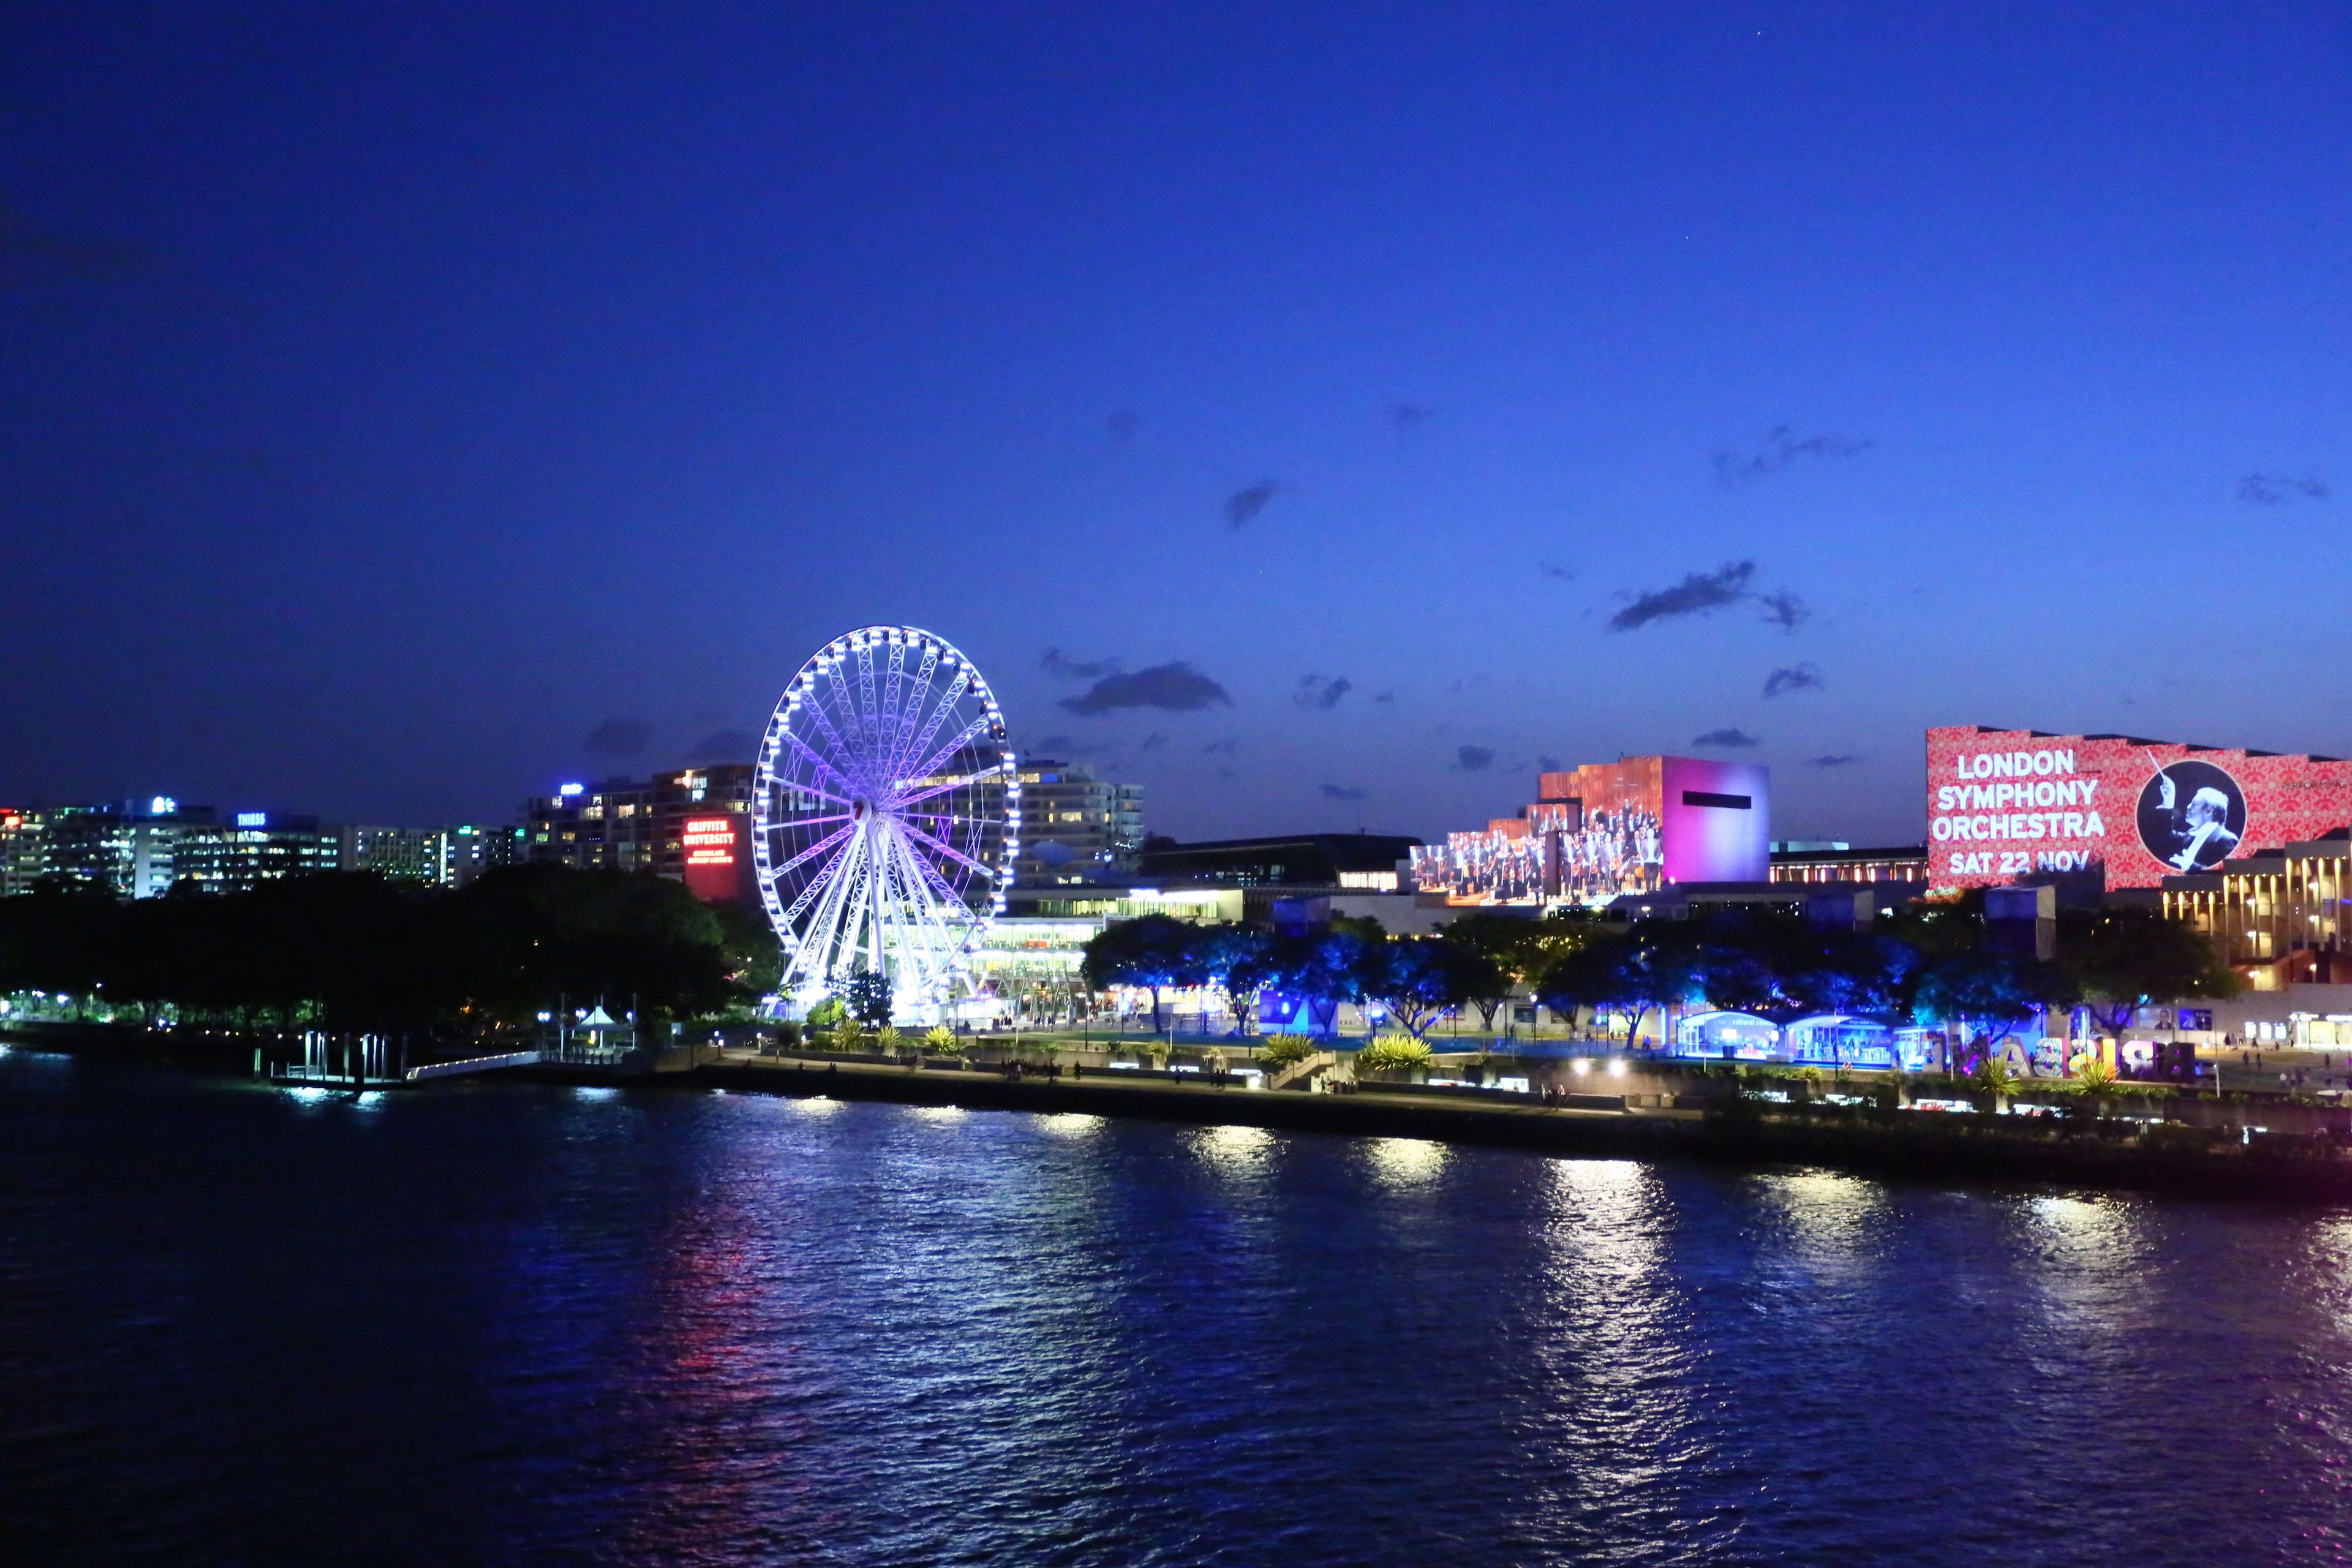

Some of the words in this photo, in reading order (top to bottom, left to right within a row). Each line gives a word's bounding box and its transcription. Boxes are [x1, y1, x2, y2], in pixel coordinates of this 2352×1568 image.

[1958, 749, 2075, 779] LONDON
[1937, 779, 2099, 810] SYMPHONY
[683, 833, 734, 845] UNIVERSITY
[687, 820, 728, 833] GRIFFITH
[1932, 811, 2105, 841] ORCHESTRA
[1950, 852, 1994, 874] SAT
[1999, 851, 2030, 874] 22
[2037, 850, 2090, 872] NOV
